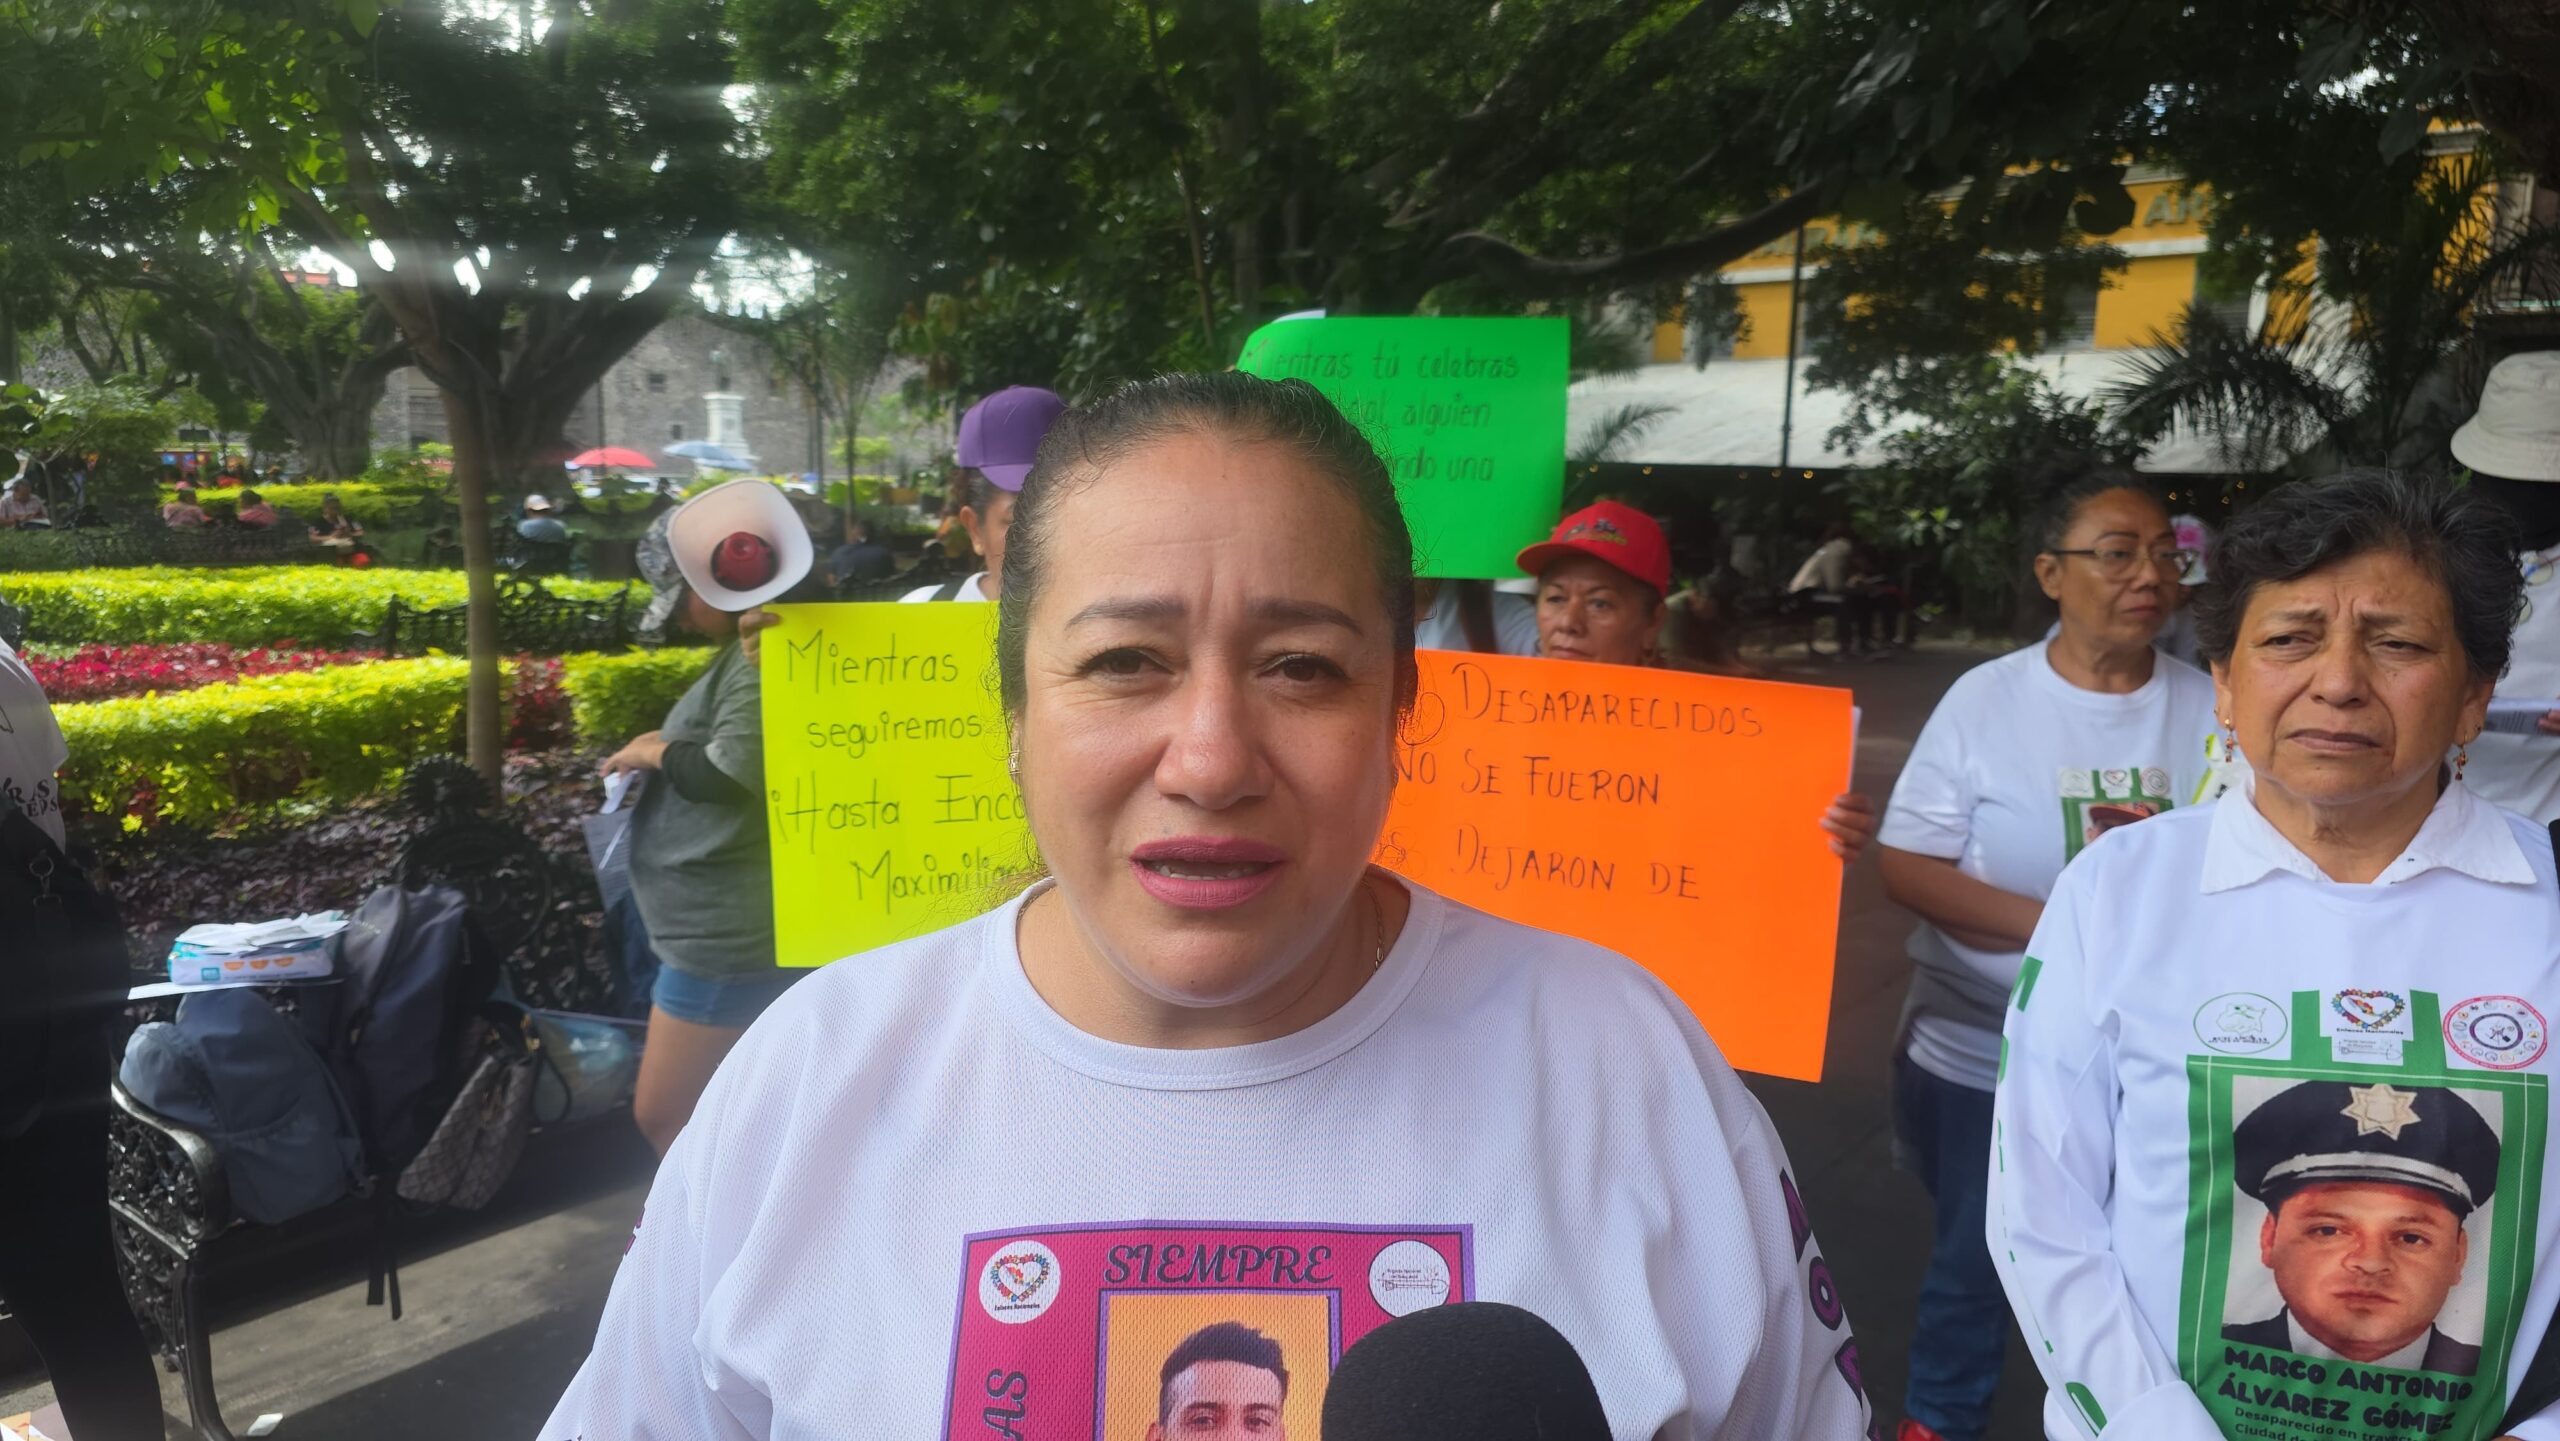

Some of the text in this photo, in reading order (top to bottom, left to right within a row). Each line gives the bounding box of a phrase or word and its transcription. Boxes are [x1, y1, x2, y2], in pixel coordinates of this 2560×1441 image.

[1372, 336, 1400, 379] tú
[1417, 347, 1521, 379] celebras
[1402, 390, 1492, 437] alguien
[1447, 455, 1495, 482] una
[786, 628, 960, 694] Mientras
[1451, 662, 1764, 737] DESAPARECIDOS
[806, 711, 983, 759] seguiremos
[1460, 748, 1502, 794] SE
[1522, 755, 1661, 806] FUERON
[771, 769, 900, 855] ¡Hasta
[1450, 824, 1616, 892] DEJARON
[1650, 861, 1701, 900] DE
[1103, 1242, 1335, 1285] SIEMPRE
[2224, 1346, 2474, 1403] MARCO ANTONIO
[2217, 1371, 2457, 1436] ÁLVAREZ GÓMEZ
[2234, 1406, 2335, 1435] Desaparecido
[2338, 1427, 2357, 1440] en
[2234, 1422, 2287, 1441] Ciudad
